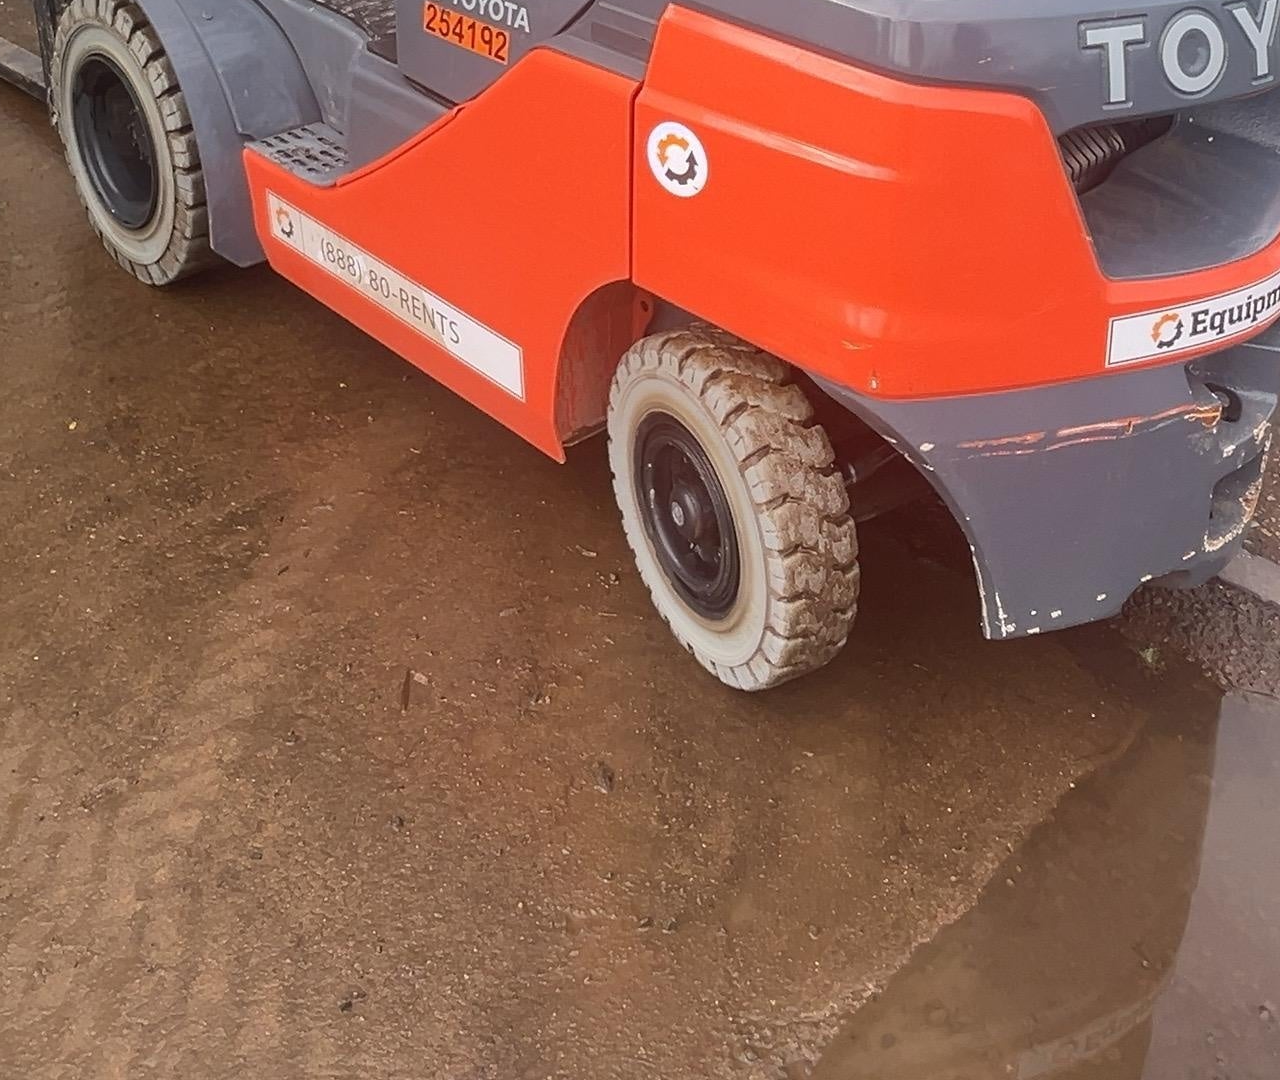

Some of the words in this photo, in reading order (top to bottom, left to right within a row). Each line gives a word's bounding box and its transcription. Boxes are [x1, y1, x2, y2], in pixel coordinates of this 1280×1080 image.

[425, 4, 507, 62] 254192
[320, 237, 362, 284] (888)
[369, 269, 461, 344] 80-RENTS
